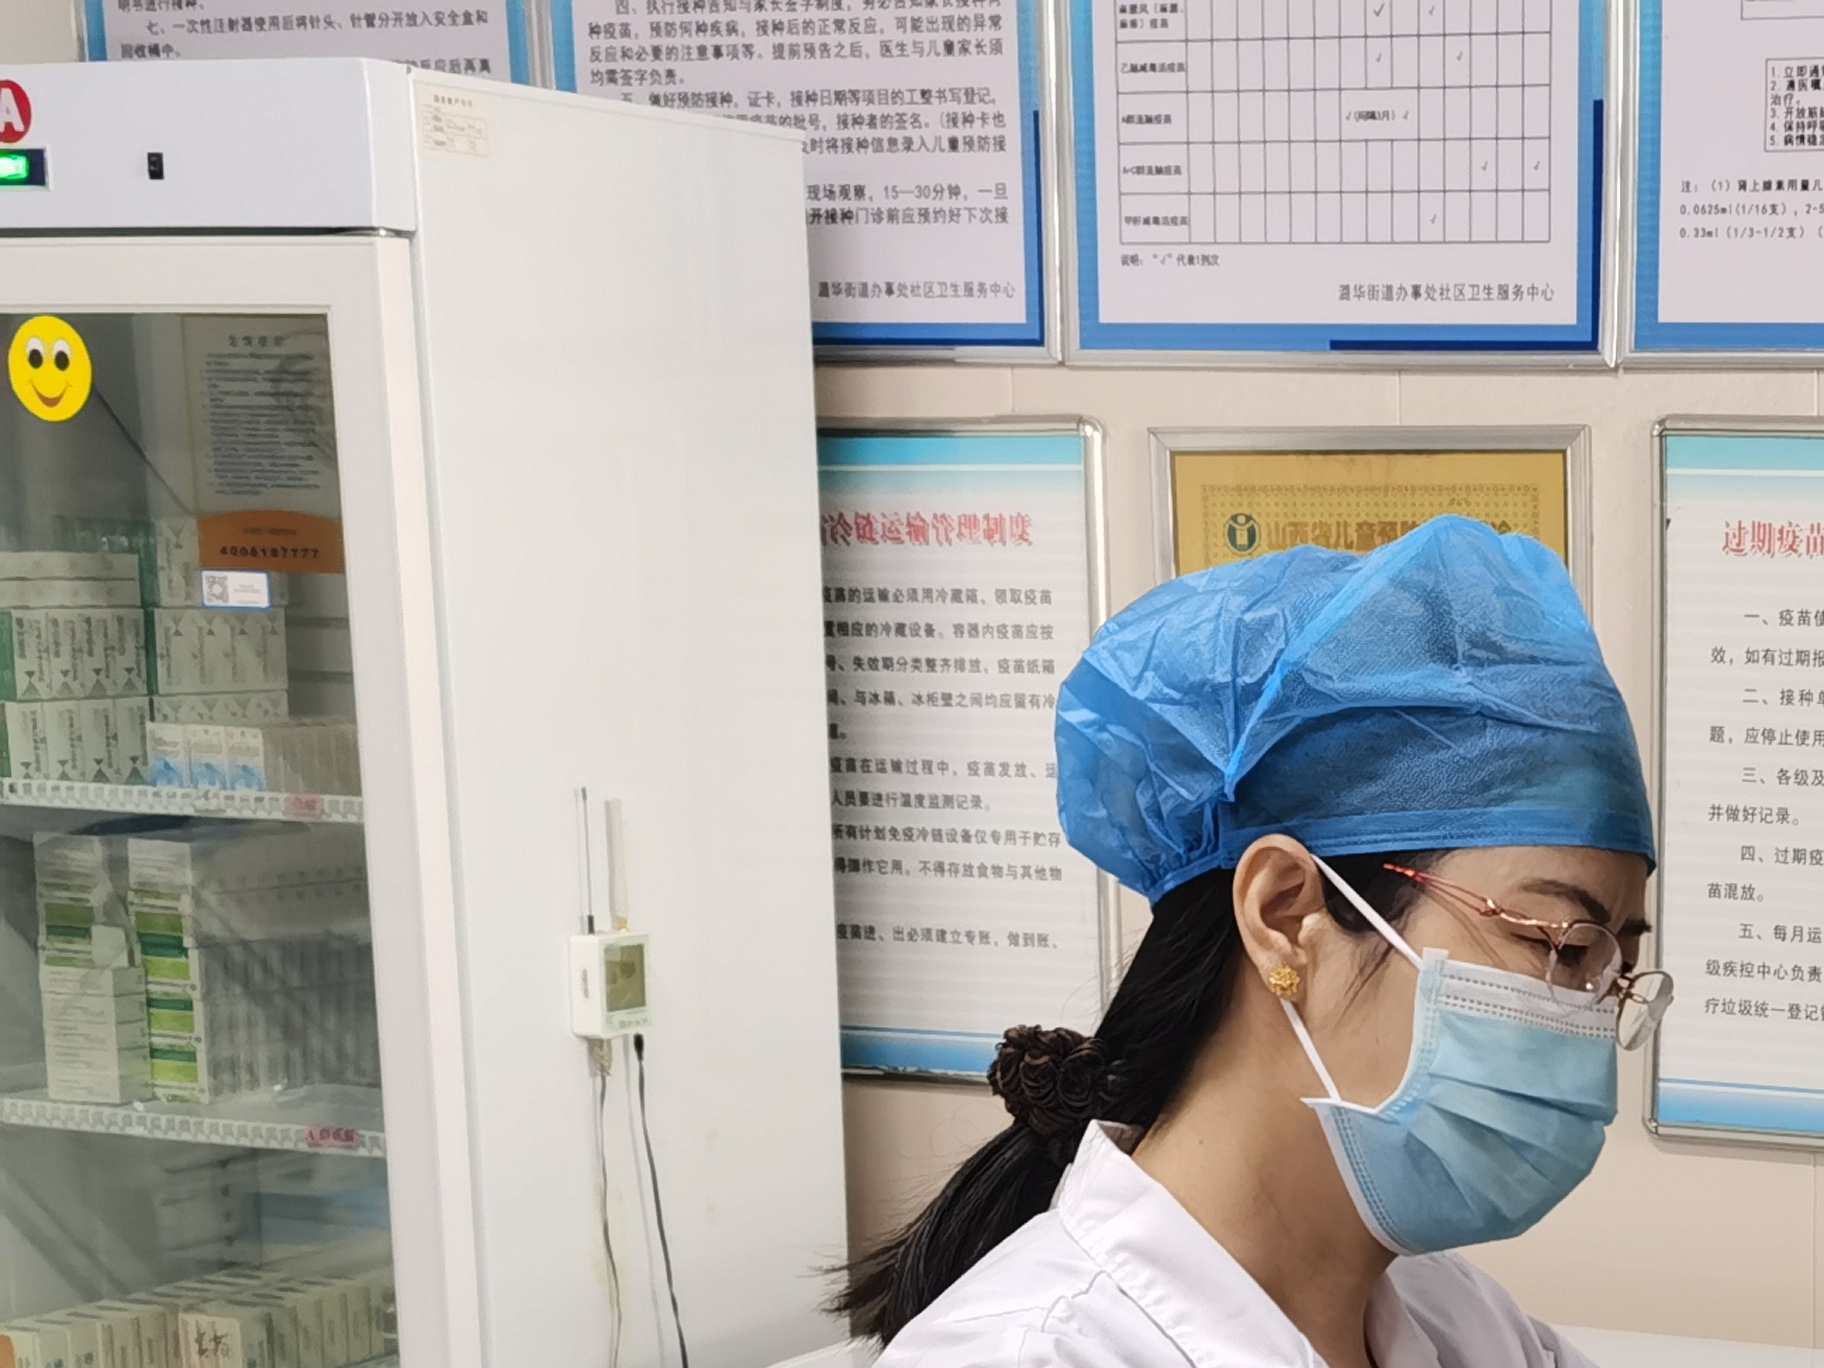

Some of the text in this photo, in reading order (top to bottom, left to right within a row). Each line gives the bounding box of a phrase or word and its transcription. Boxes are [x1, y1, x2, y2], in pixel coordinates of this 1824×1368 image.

[590, 68, 685, 87] 均需签字负责。
[1708, 803, 1801, 827] 并做好记录。
[1707, 883, 1765, 903] 苗混放。
